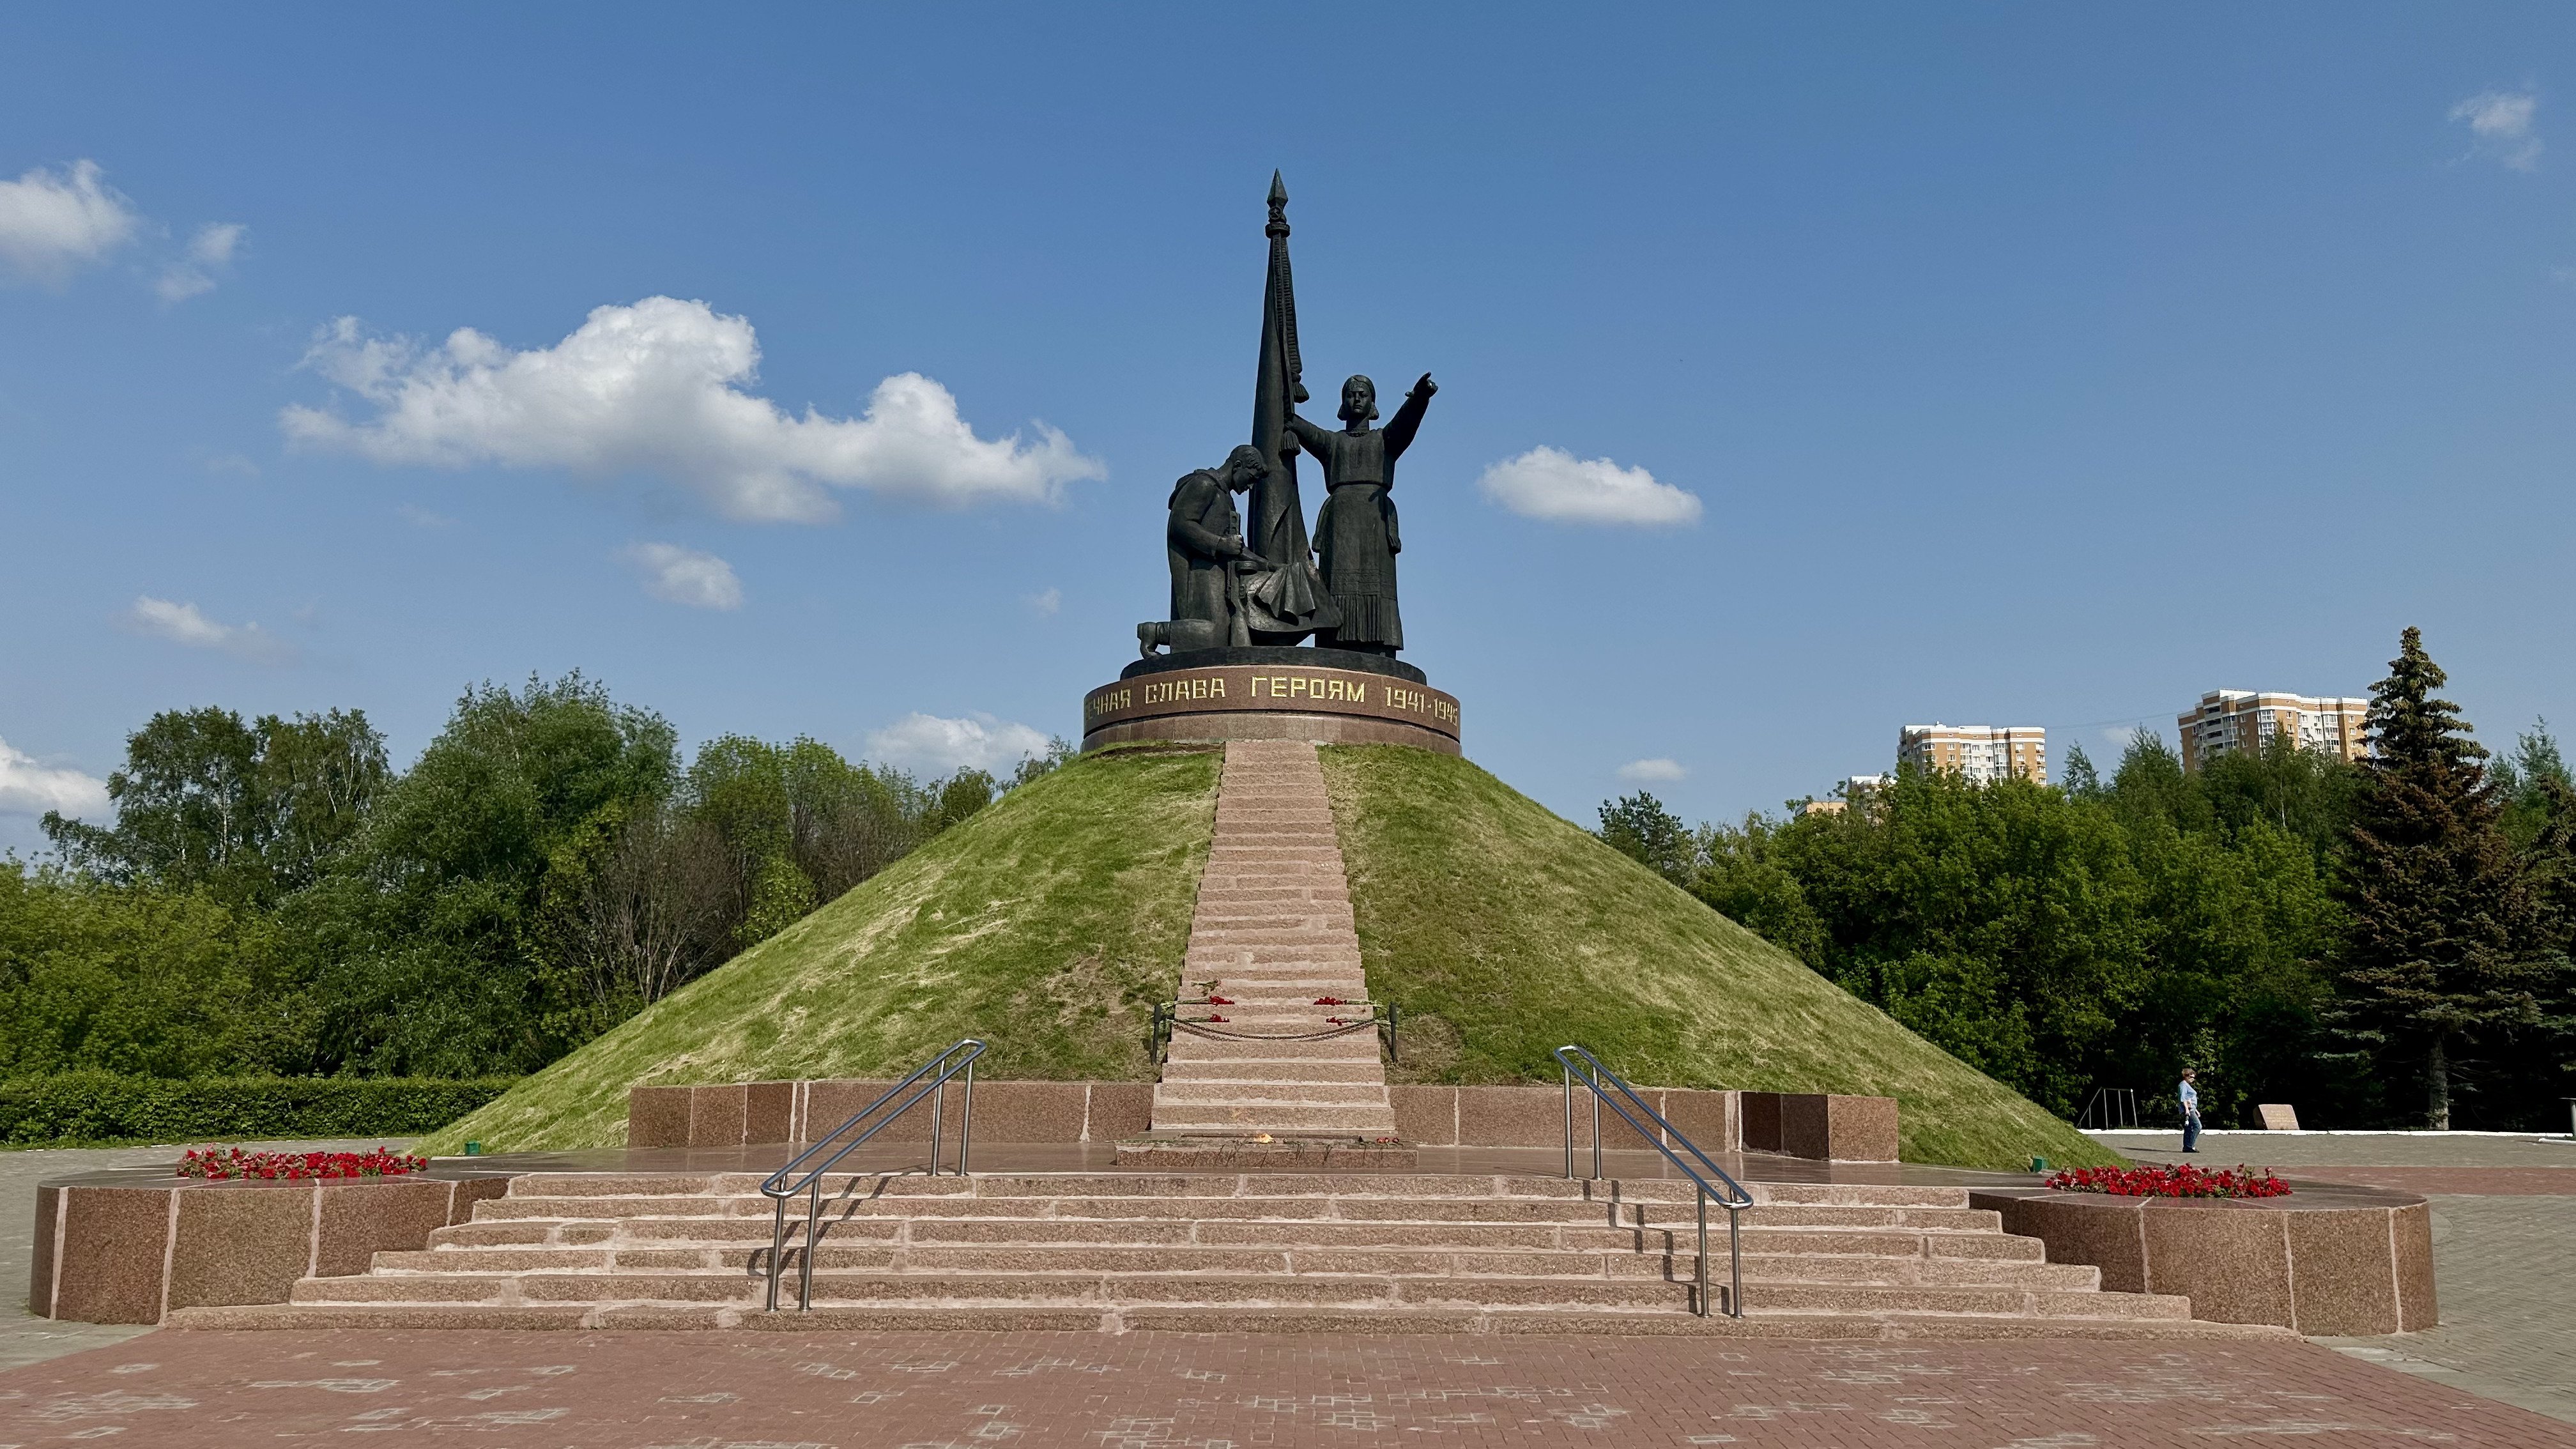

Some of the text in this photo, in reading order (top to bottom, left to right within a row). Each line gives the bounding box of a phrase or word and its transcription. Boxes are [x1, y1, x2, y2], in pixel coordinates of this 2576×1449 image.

[1086, 689, 1131, 720] ЕЧНАЯ
[1145, 677, 1226, 704] СЛАВА
[1251, 676, 1365, 703] ГЕРОЯМ
